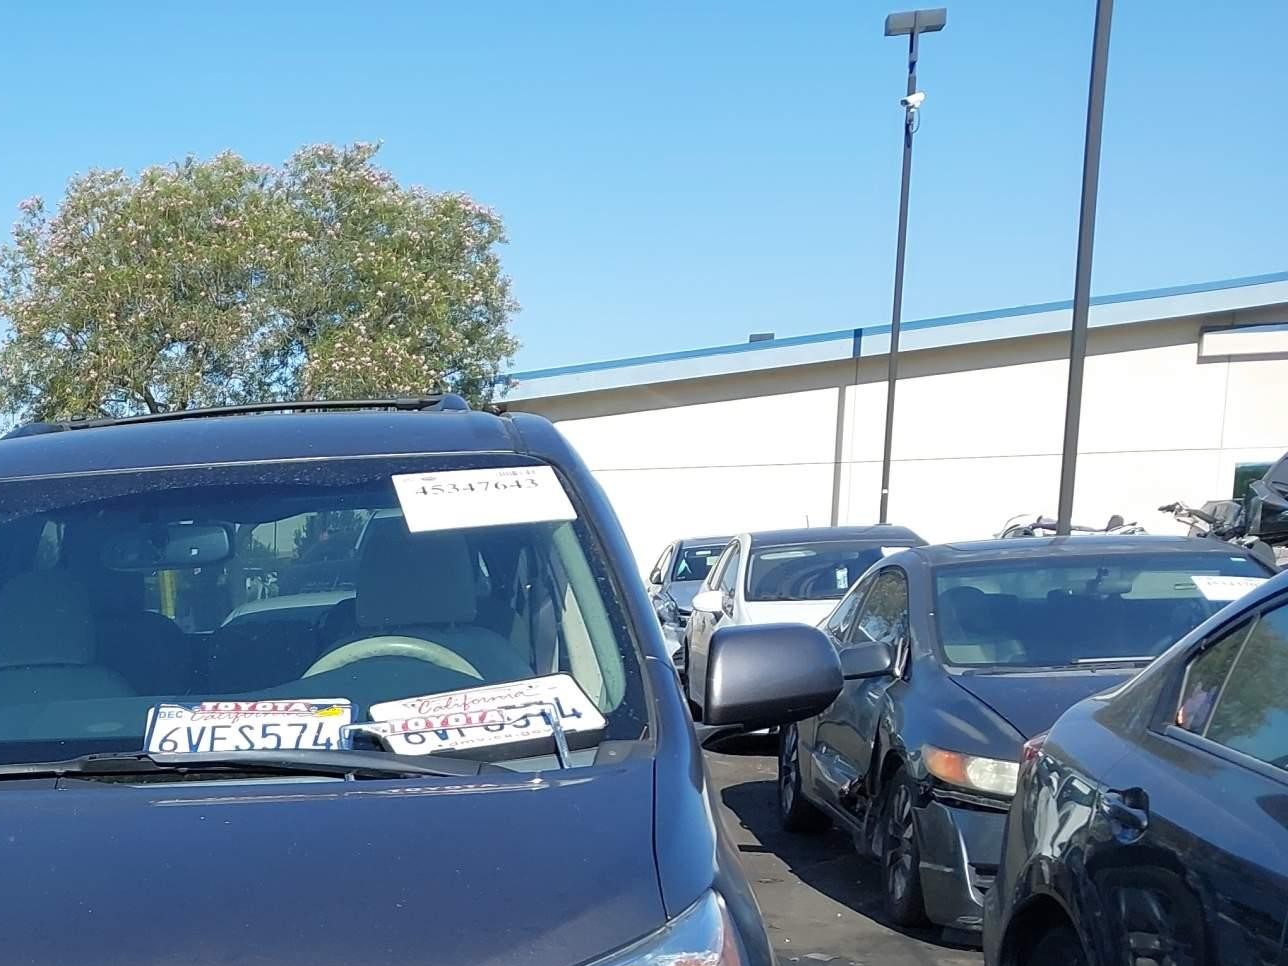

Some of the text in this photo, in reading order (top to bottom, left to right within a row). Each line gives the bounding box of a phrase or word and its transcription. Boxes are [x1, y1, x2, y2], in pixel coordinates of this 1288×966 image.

[415, 478, 539, 496] 45347643
[201, 702, 309, 712] TOYOTA
[418, 689, 532, 714] California
[159, 710, 183, 719] DEC
[391, 709, 502, 732] TOYOTA
[158, 722, 335, 752] 6VFS574
